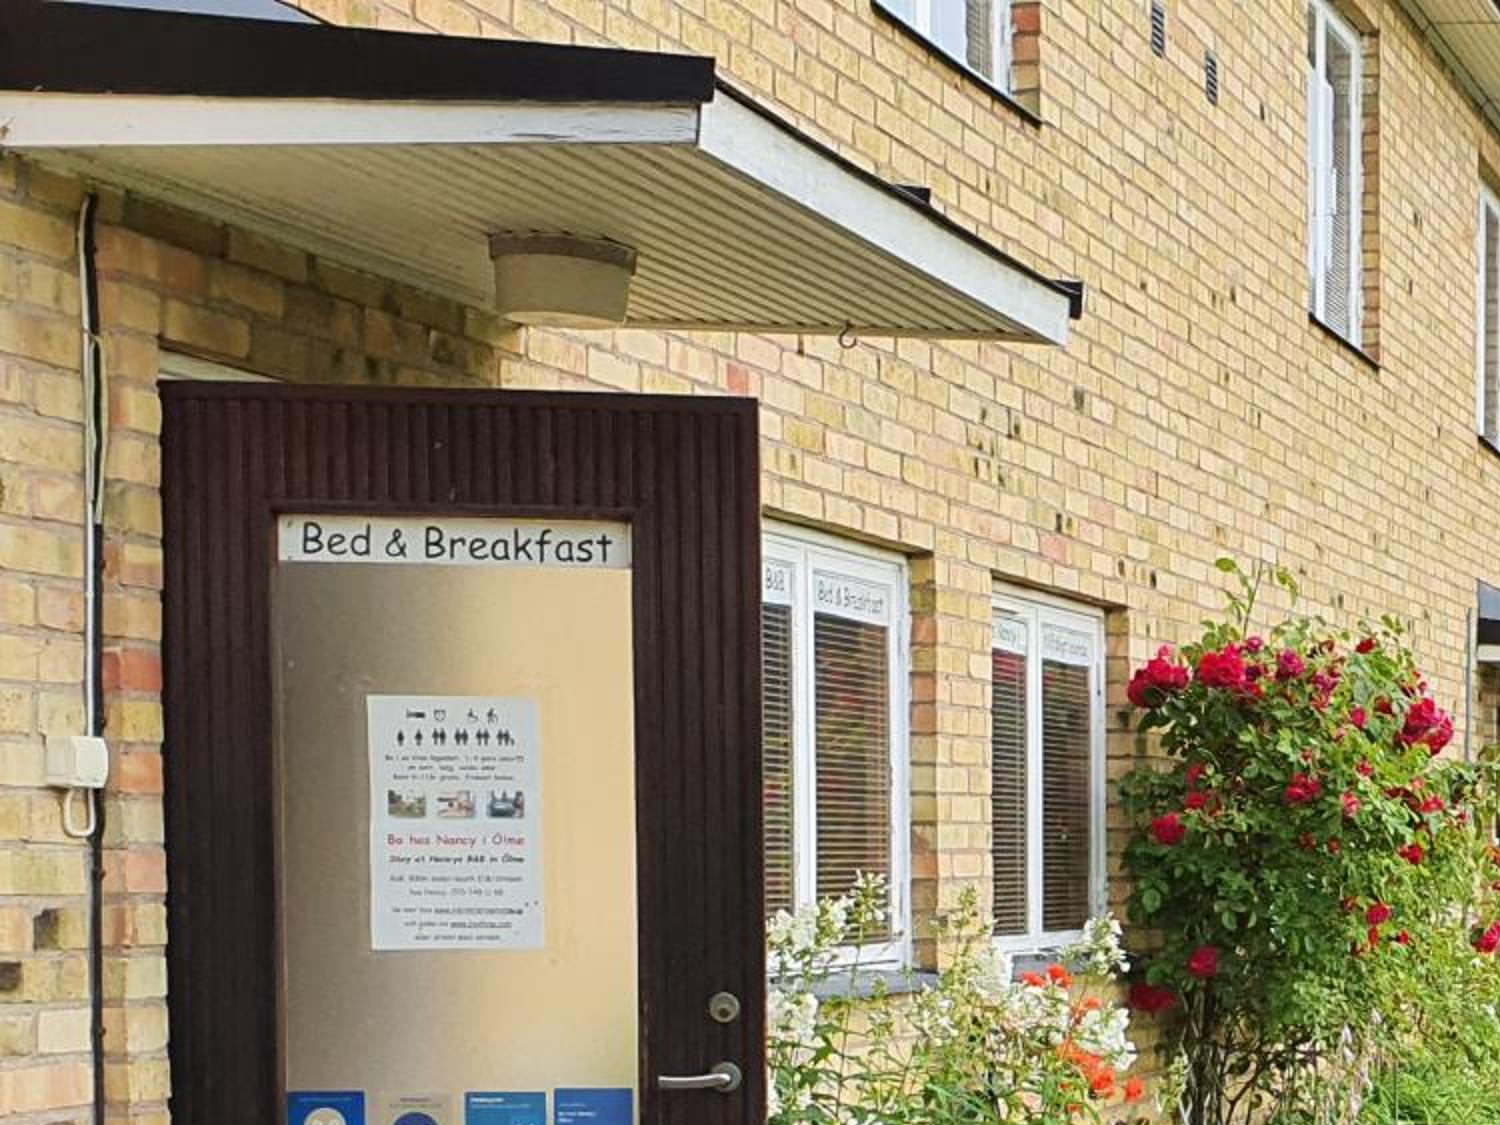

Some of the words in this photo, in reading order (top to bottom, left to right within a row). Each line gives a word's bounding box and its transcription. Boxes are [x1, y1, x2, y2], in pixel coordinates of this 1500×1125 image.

[302, 520, 371, 556] Bed
[385, 526, 408, 558] &
[424, 524, 613, 564] Breakfast
[436, 834, 476, 849] Nancy
